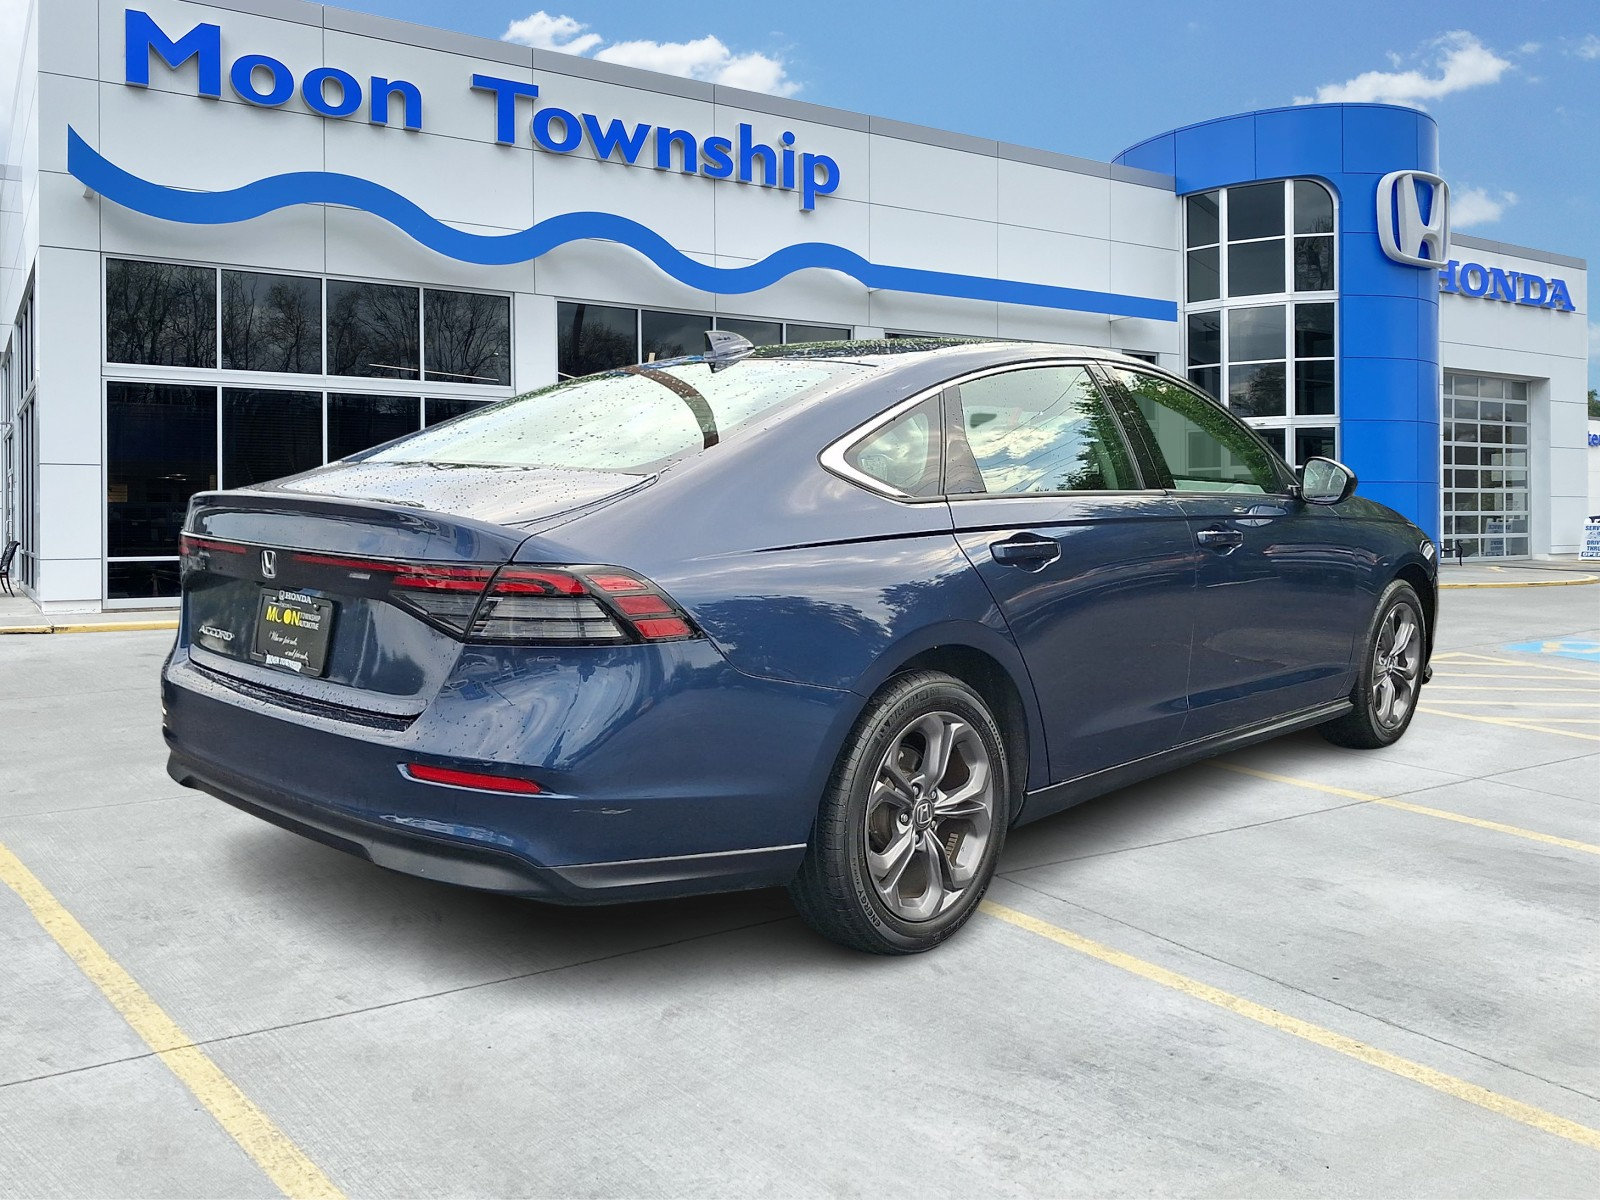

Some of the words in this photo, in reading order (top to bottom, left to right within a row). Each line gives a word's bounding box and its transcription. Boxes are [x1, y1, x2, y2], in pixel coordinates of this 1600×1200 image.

[125, 9, 422, 130] Moon
[470, 73, 841, 212] Township
[285, 591, 312, 604] HONDA
[266, 605, 300, 627] MOON
[198, 624, 233, 641] ACCORD
[857, 889, 881, 927] ENERGY
